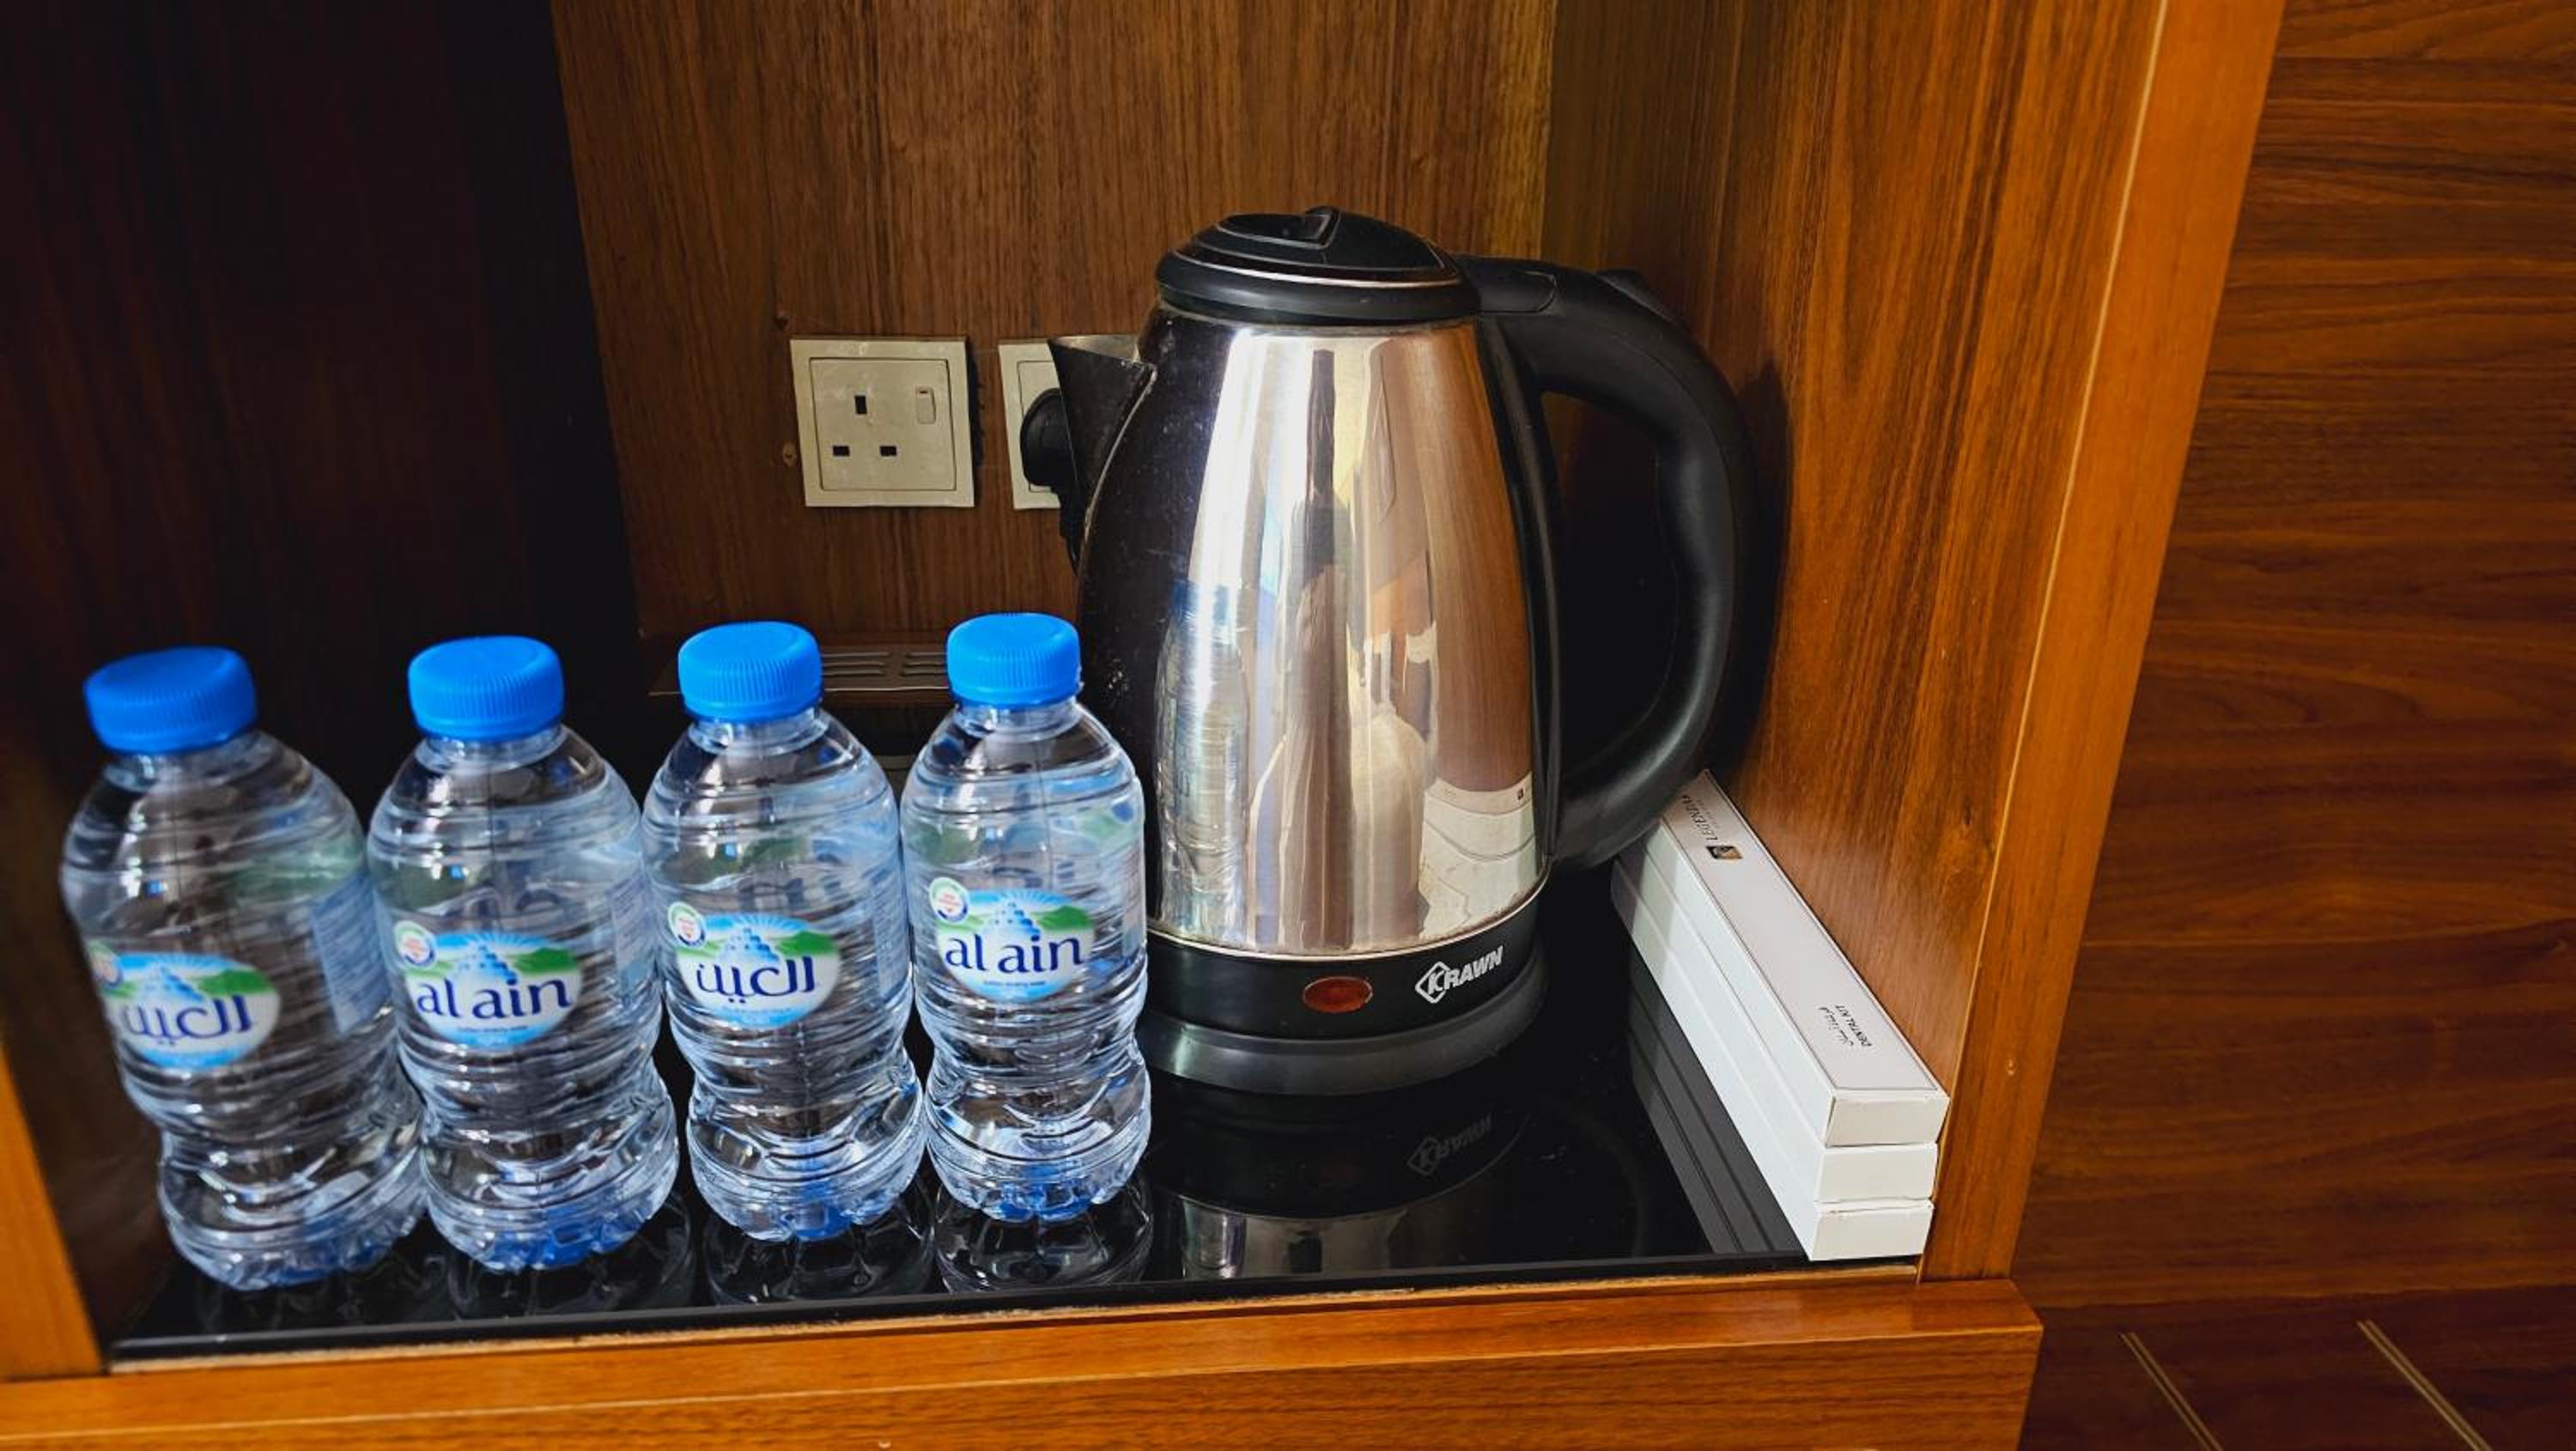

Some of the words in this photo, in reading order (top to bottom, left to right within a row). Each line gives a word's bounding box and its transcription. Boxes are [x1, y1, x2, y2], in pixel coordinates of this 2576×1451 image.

[945, 932, 987, 971] al
[997, 933, 1084, 974] ain
[1426, 945, 1504, 995] KRAWN
[416, 977, 461, 1018] al
[471, 977, 574, 1020] ain
[696, 955, 817, 1005] العين
